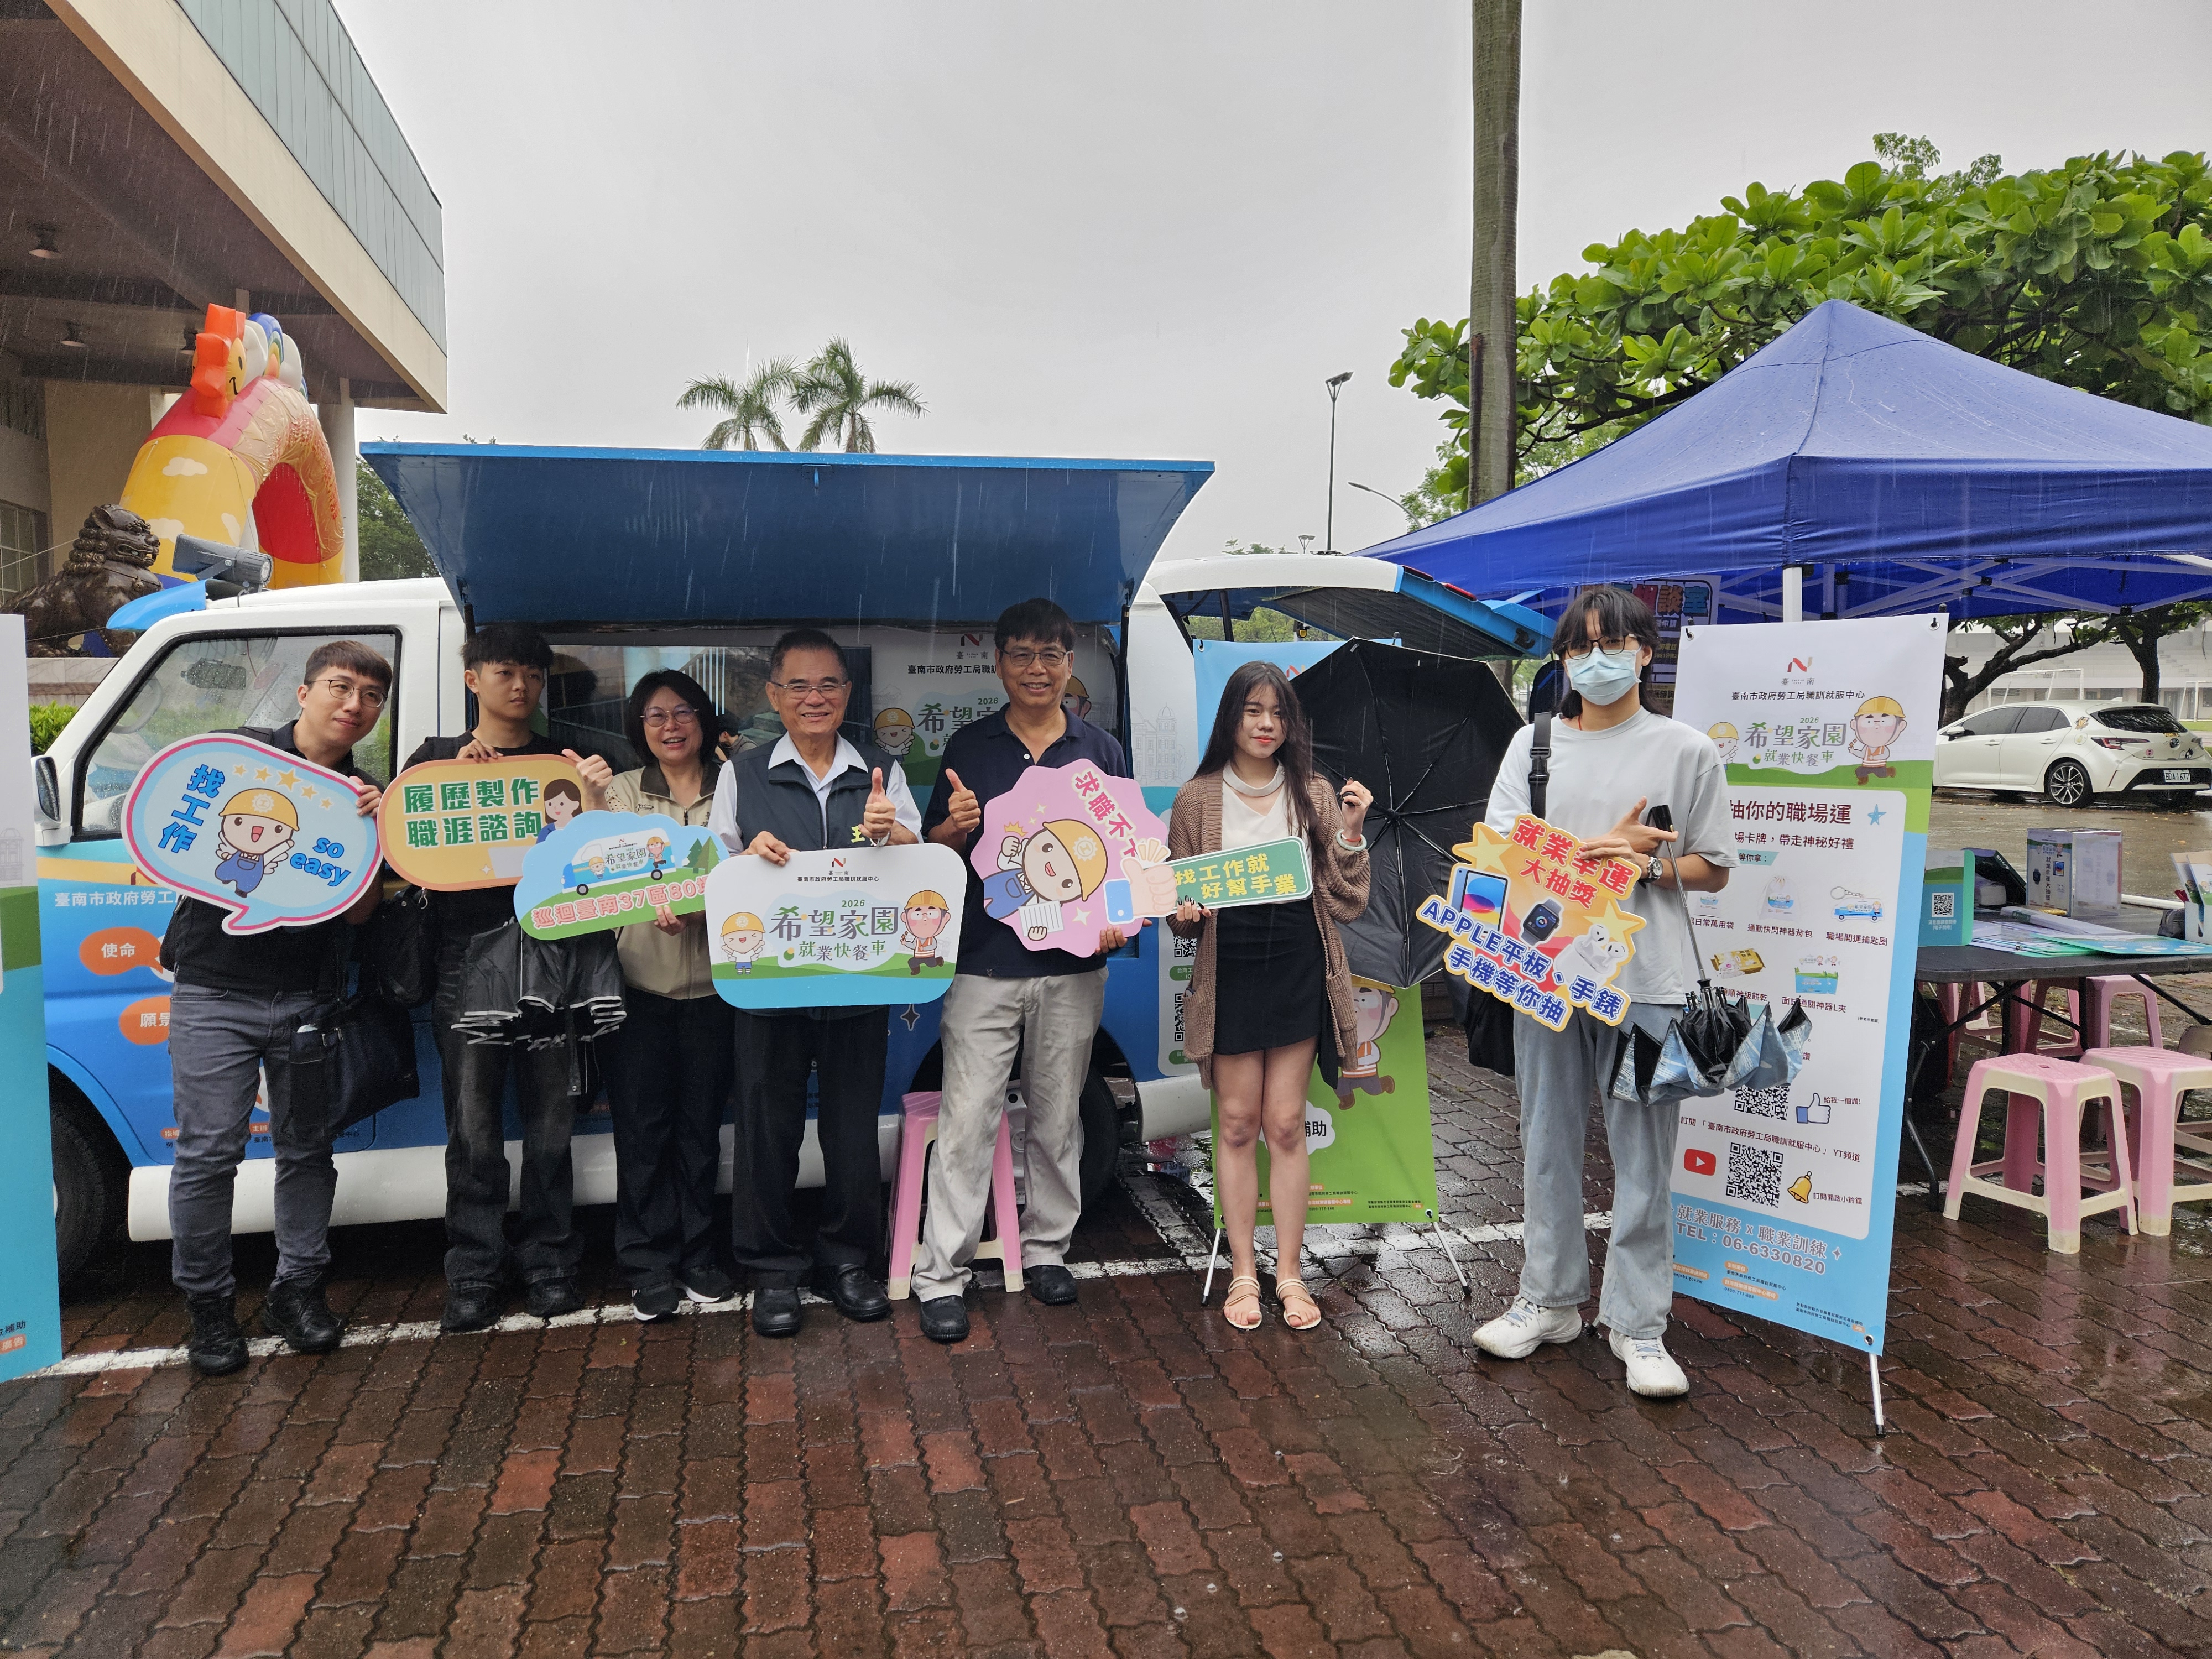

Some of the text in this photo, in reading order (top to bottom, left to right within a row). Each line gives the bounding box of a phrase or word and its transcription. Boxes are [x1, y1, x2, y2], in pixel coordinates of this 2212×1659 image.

[1731, 690, 1865, 701] 臺南市政府勞工局職訓就服中心
[1744, 722, 1848, 749] 希望家園
[1764, 749, 1834, 766] 就業快餐車
[404, 778, 540, 813] 履歷製作
[158, 764, 225, 853] 找工作
[406, 811, 542, 848] 職涯諮詢
[313, 837, 345, 858] so
[290, 853, 351, 887] easy
[1520, 858, 1598, 910] 大抽獎
[55, 890, 178, 906] 臺南市政府勞工
[842, 899, 865, 907] 2026
[769, 905, 899, 941] 希望家園
[101, 942, 135, 958] 使命
[798, 940, 886, 961] 就業快餐車
[1449, 946, 1567, 1027] 手機等你抽
[140, 1011, 170, 1027] 願景
[1833, 1149, 1861, 1162] YT頻道
[1676, 1204, 1741, 1235] 就業服務
[1757, 1225, 1827, 1259] 職業訓練
